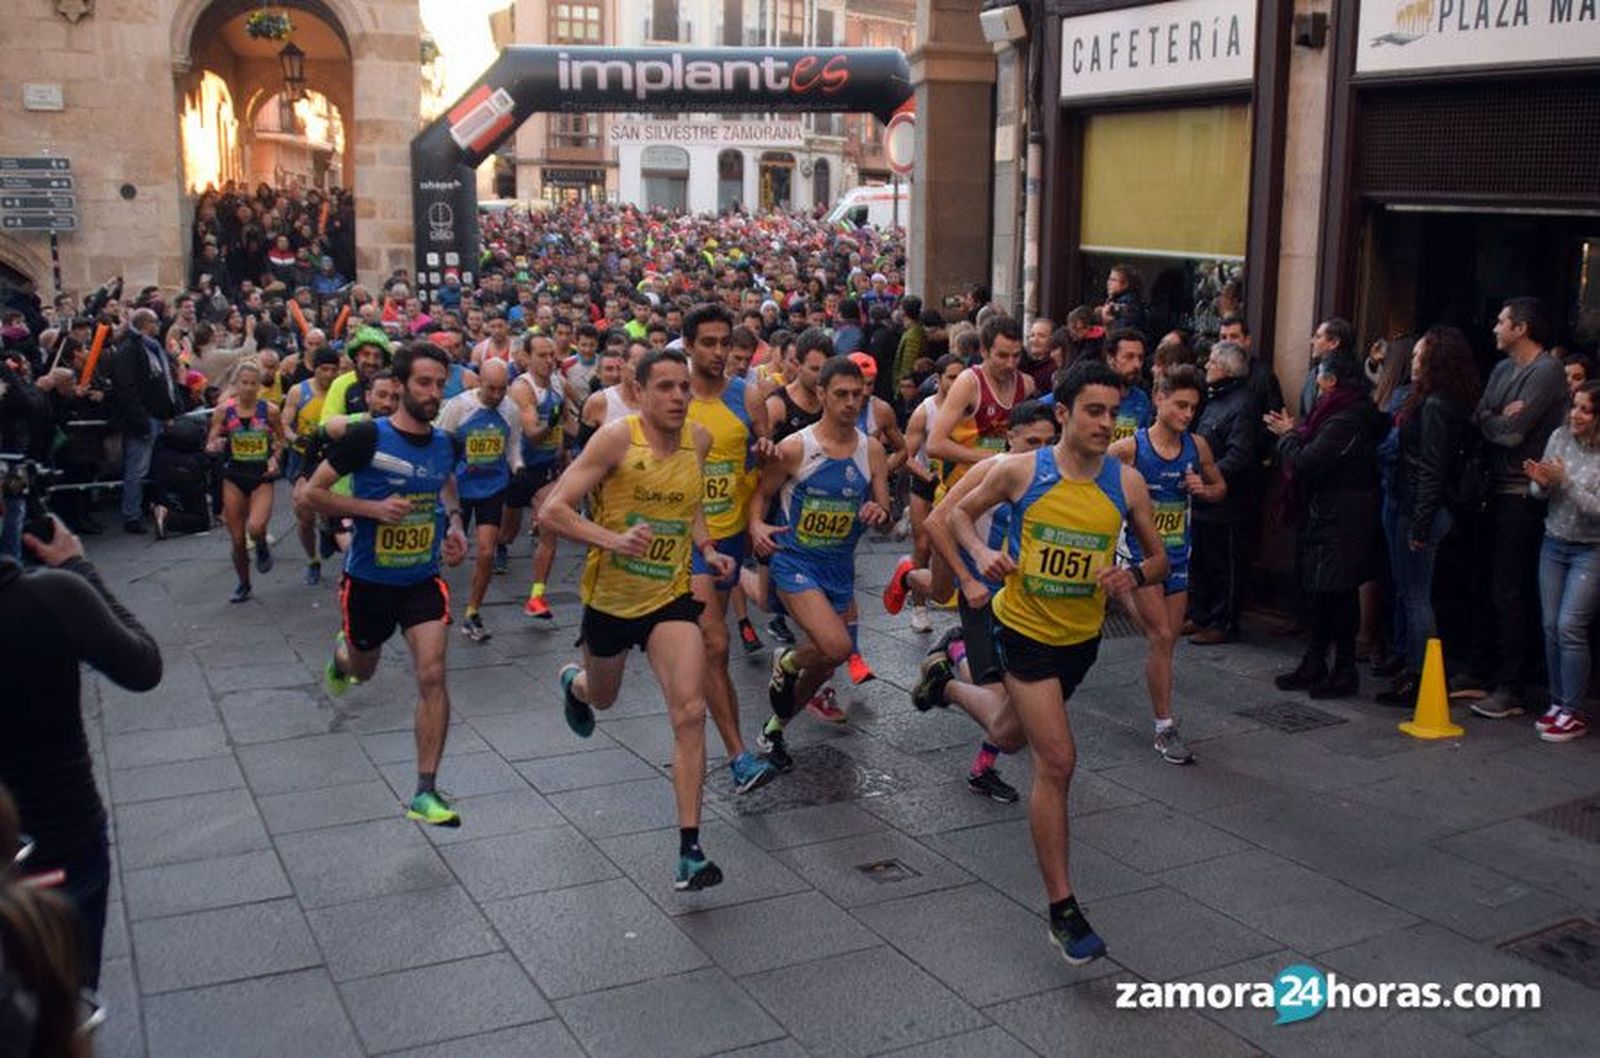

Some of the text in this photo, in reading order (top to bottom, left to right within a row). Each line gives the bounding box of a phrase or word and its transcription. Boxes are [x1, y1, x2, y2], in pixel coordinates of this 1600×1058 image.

[1439, 0, 1529, 32] PLAZA
[557, 52, 850, 100] implantes
[610, 125, 801, 141] SAN SILVESTRE ZAMORANA
[804, 512, 850, 534] 0842
[381, 527, 431, 551] 0930
[1038, 547, 1092, 579] 1051
